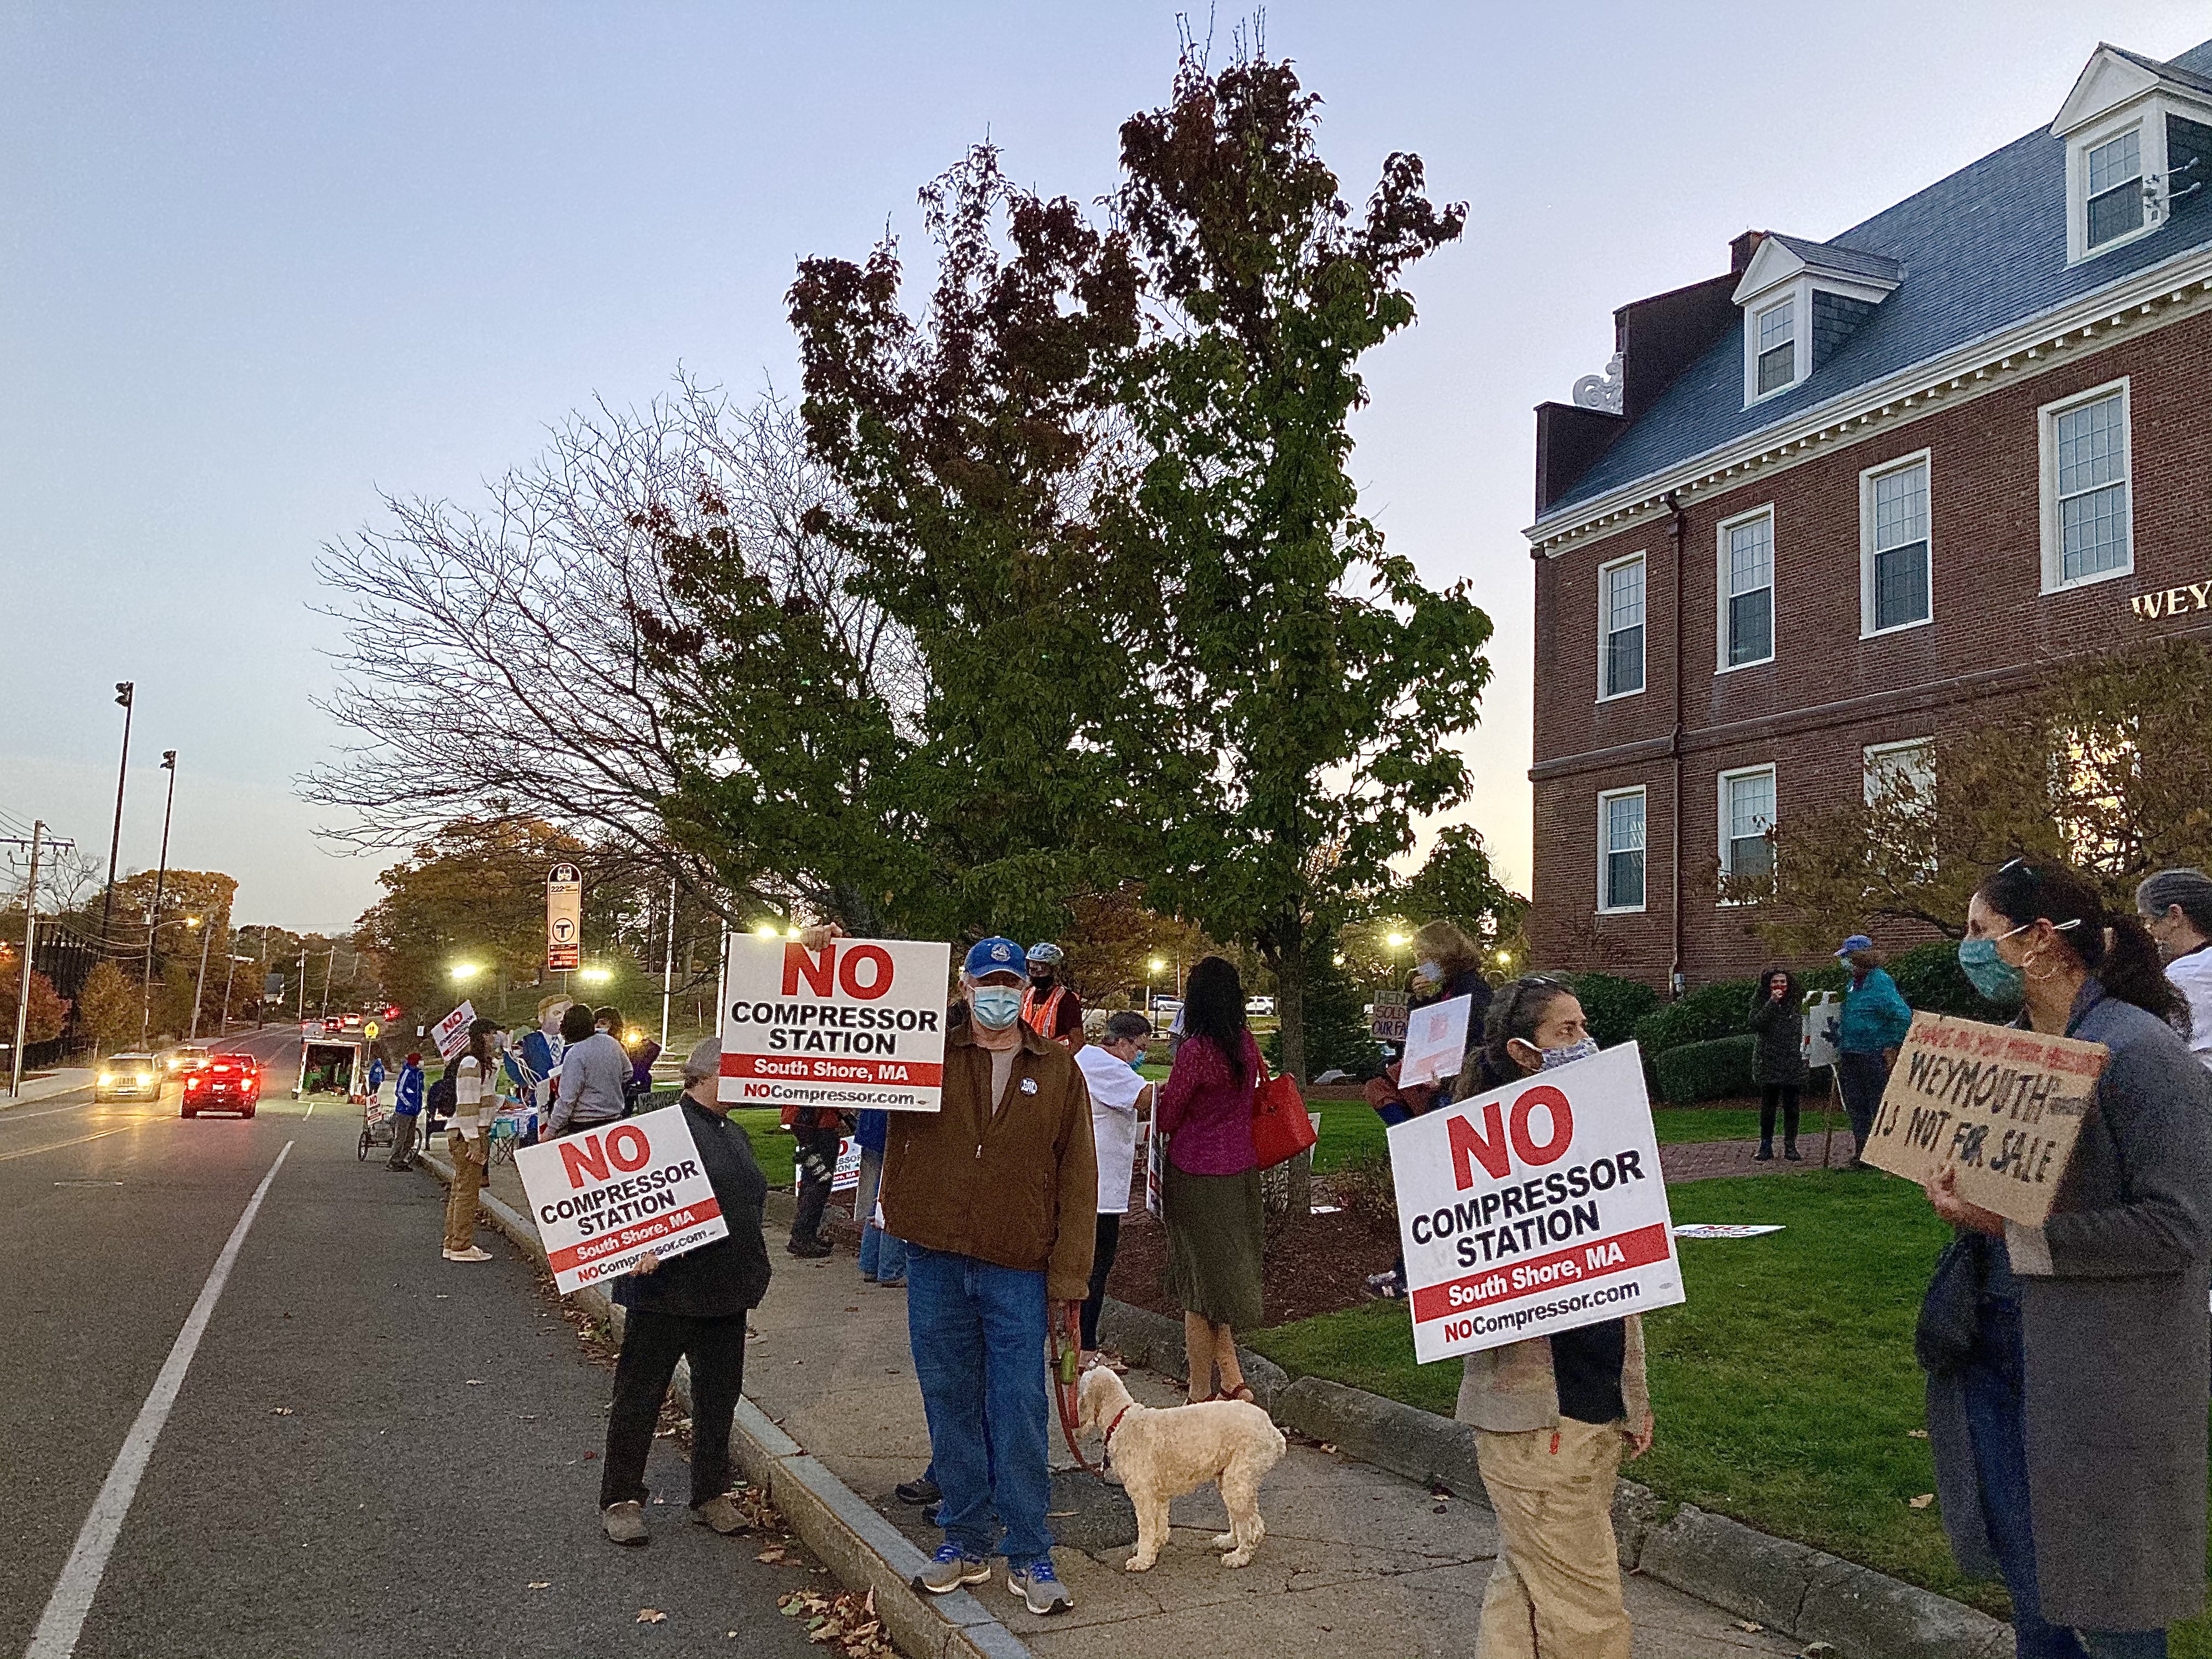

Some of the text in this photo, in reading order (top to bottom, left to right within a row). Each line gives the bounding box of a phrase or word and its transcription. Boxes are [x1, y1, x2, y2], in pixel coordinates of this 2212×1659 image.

[556, 924, 571, 938] T
[781, 941, 894, 1000] NO
[442, 1011, 463, 1034] NO
[731, 1001, 939, 1032] COMPRESSOR
[769, 1028, 897, 1055] STATION
[1372, 1021, 1392, 1036] OUR
[744, 1084, 915, 1105] NOCompressor.com
[754, 1059, 909, 1081] South Shore, MA
[1907, 1051, 2054, 1125] WEYMOUTH
[370, 1095, 377, 1105] NO
[558, 1125, 651, 1189] NO
[1447, 1086, 1574, 1191] NO
[1875, 1101, 2057, 1183] IS NOT FOR SALE
[540, 1160, 699, 1224] COMPRESSOR
[578, 1189, 676, 1236] STATION
[1412, 1150, 1645, 1245] COMPRESSOR
[577, 1210, 695, 1260] South Shore, MA
[1457, 1200, 1600, 1267] STATION
[1449, 1243, 1626, 1306] South Shore, MA
[1444, 1281, 1640, 1343] NOCompressor.com
